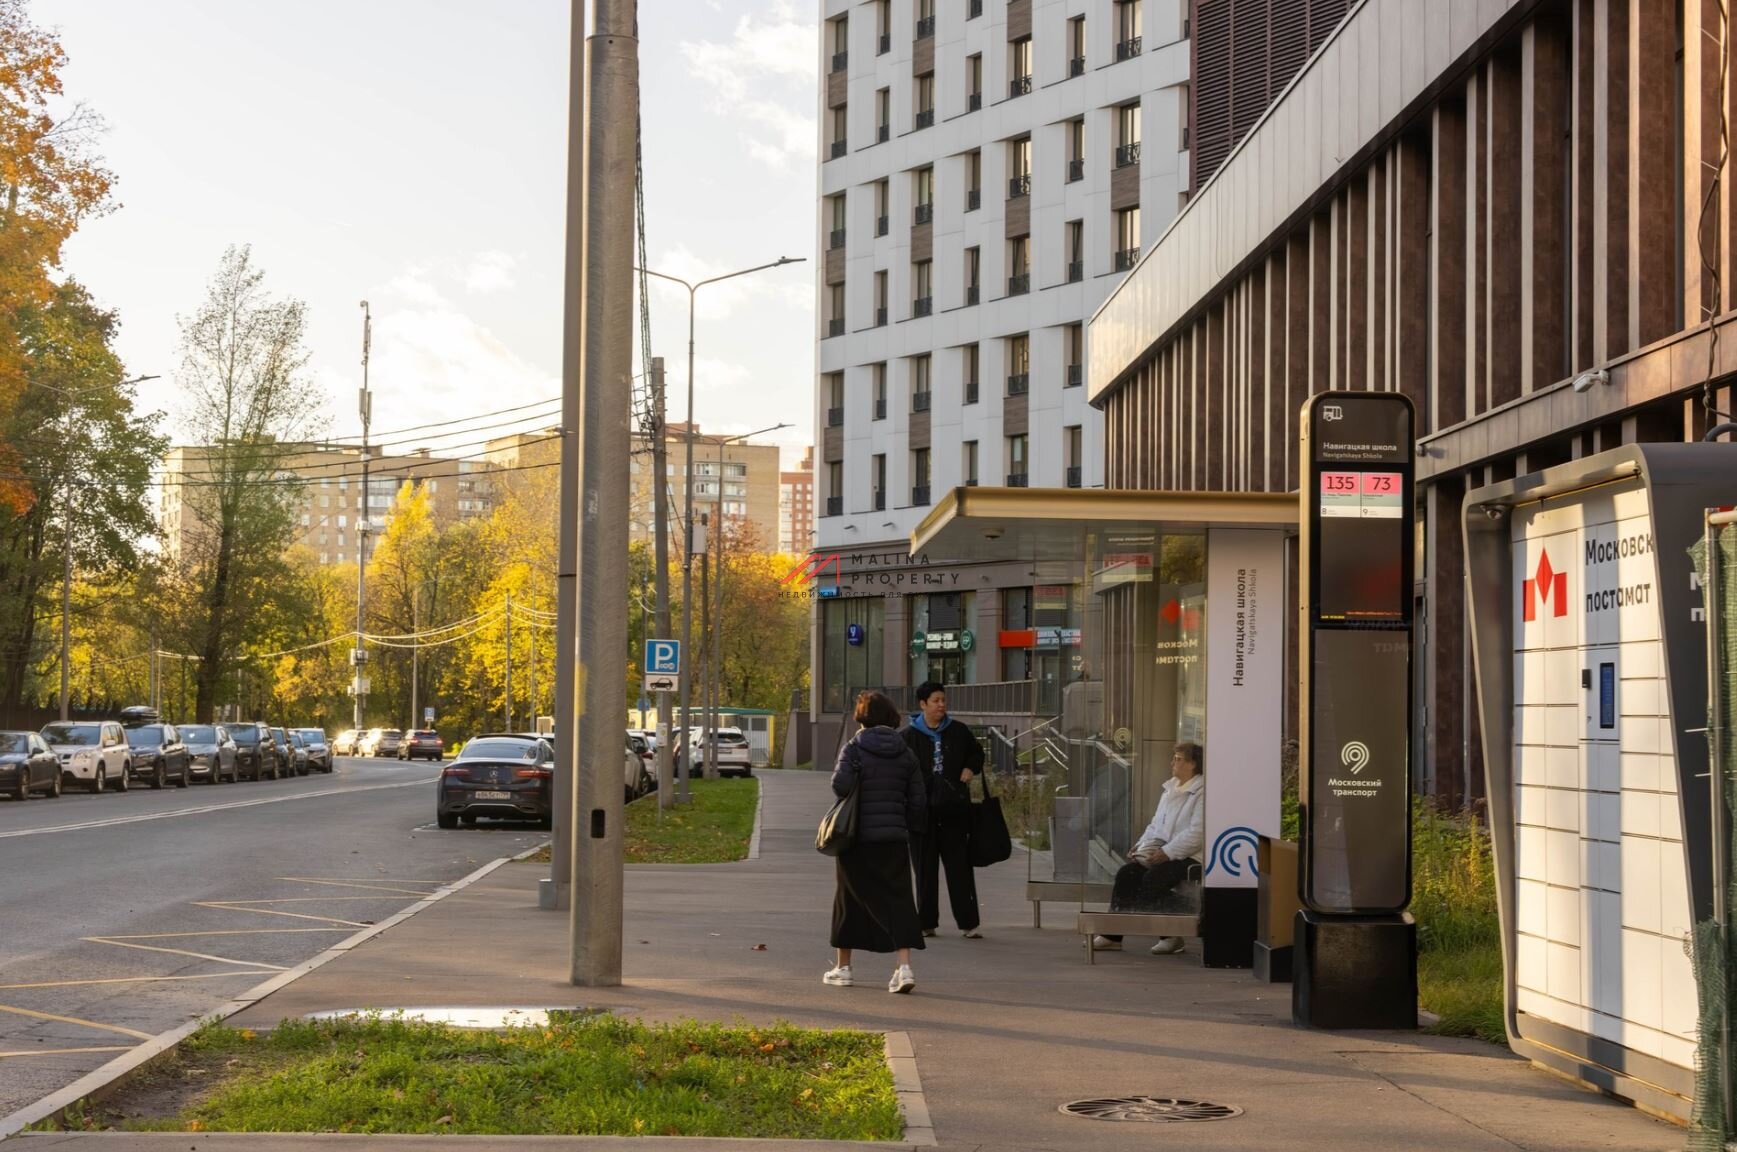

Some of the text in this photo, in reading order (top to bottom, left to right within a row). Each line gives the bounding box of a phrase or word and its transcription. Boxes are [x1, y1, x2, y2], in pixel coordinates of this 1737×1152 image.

[1323, 442, 1370, 451] Навигацкая
[1327, 476, 1354, 490] 135
[1372, 477, 1391, 490] 73
[1585, 583, 1650, 613] постамат
[1248, 569, 1256, 655] Navigatskaya Shkola
[1232, 569, 1246, 686] Навигацкая школа
[655, 643, 674, 670] P
[1327, 778, 1382, 787] Московский
[1332, 789, 1377, 797] транспорт
